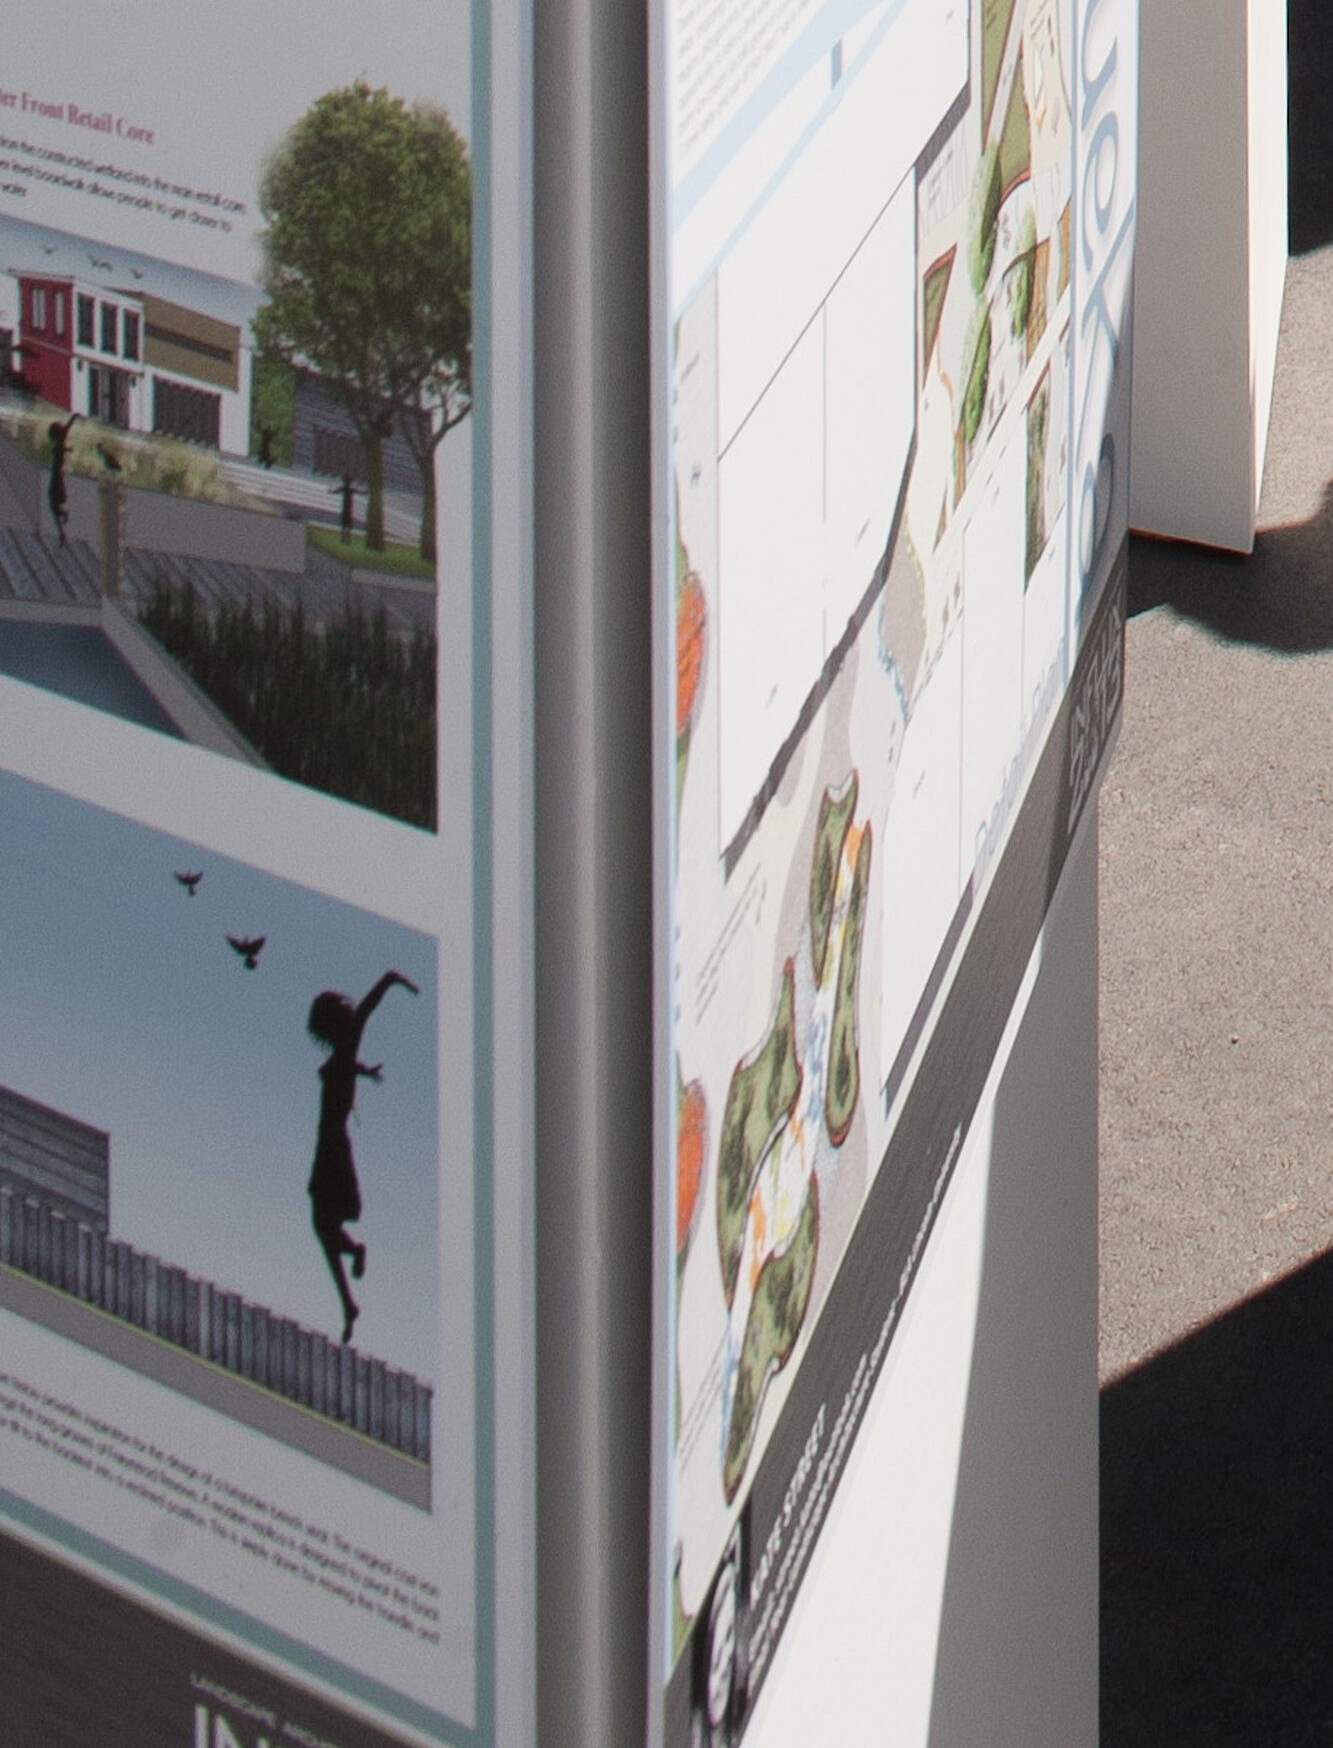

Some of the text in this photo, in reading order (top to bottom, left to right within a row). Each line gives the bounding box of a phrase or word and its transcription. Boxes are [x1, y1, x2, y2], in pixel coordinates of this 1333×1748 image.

[22, 91, 64, 120] Front
[68, 103, 112, 134] Retail
[116, 116, 155, 144] Core
